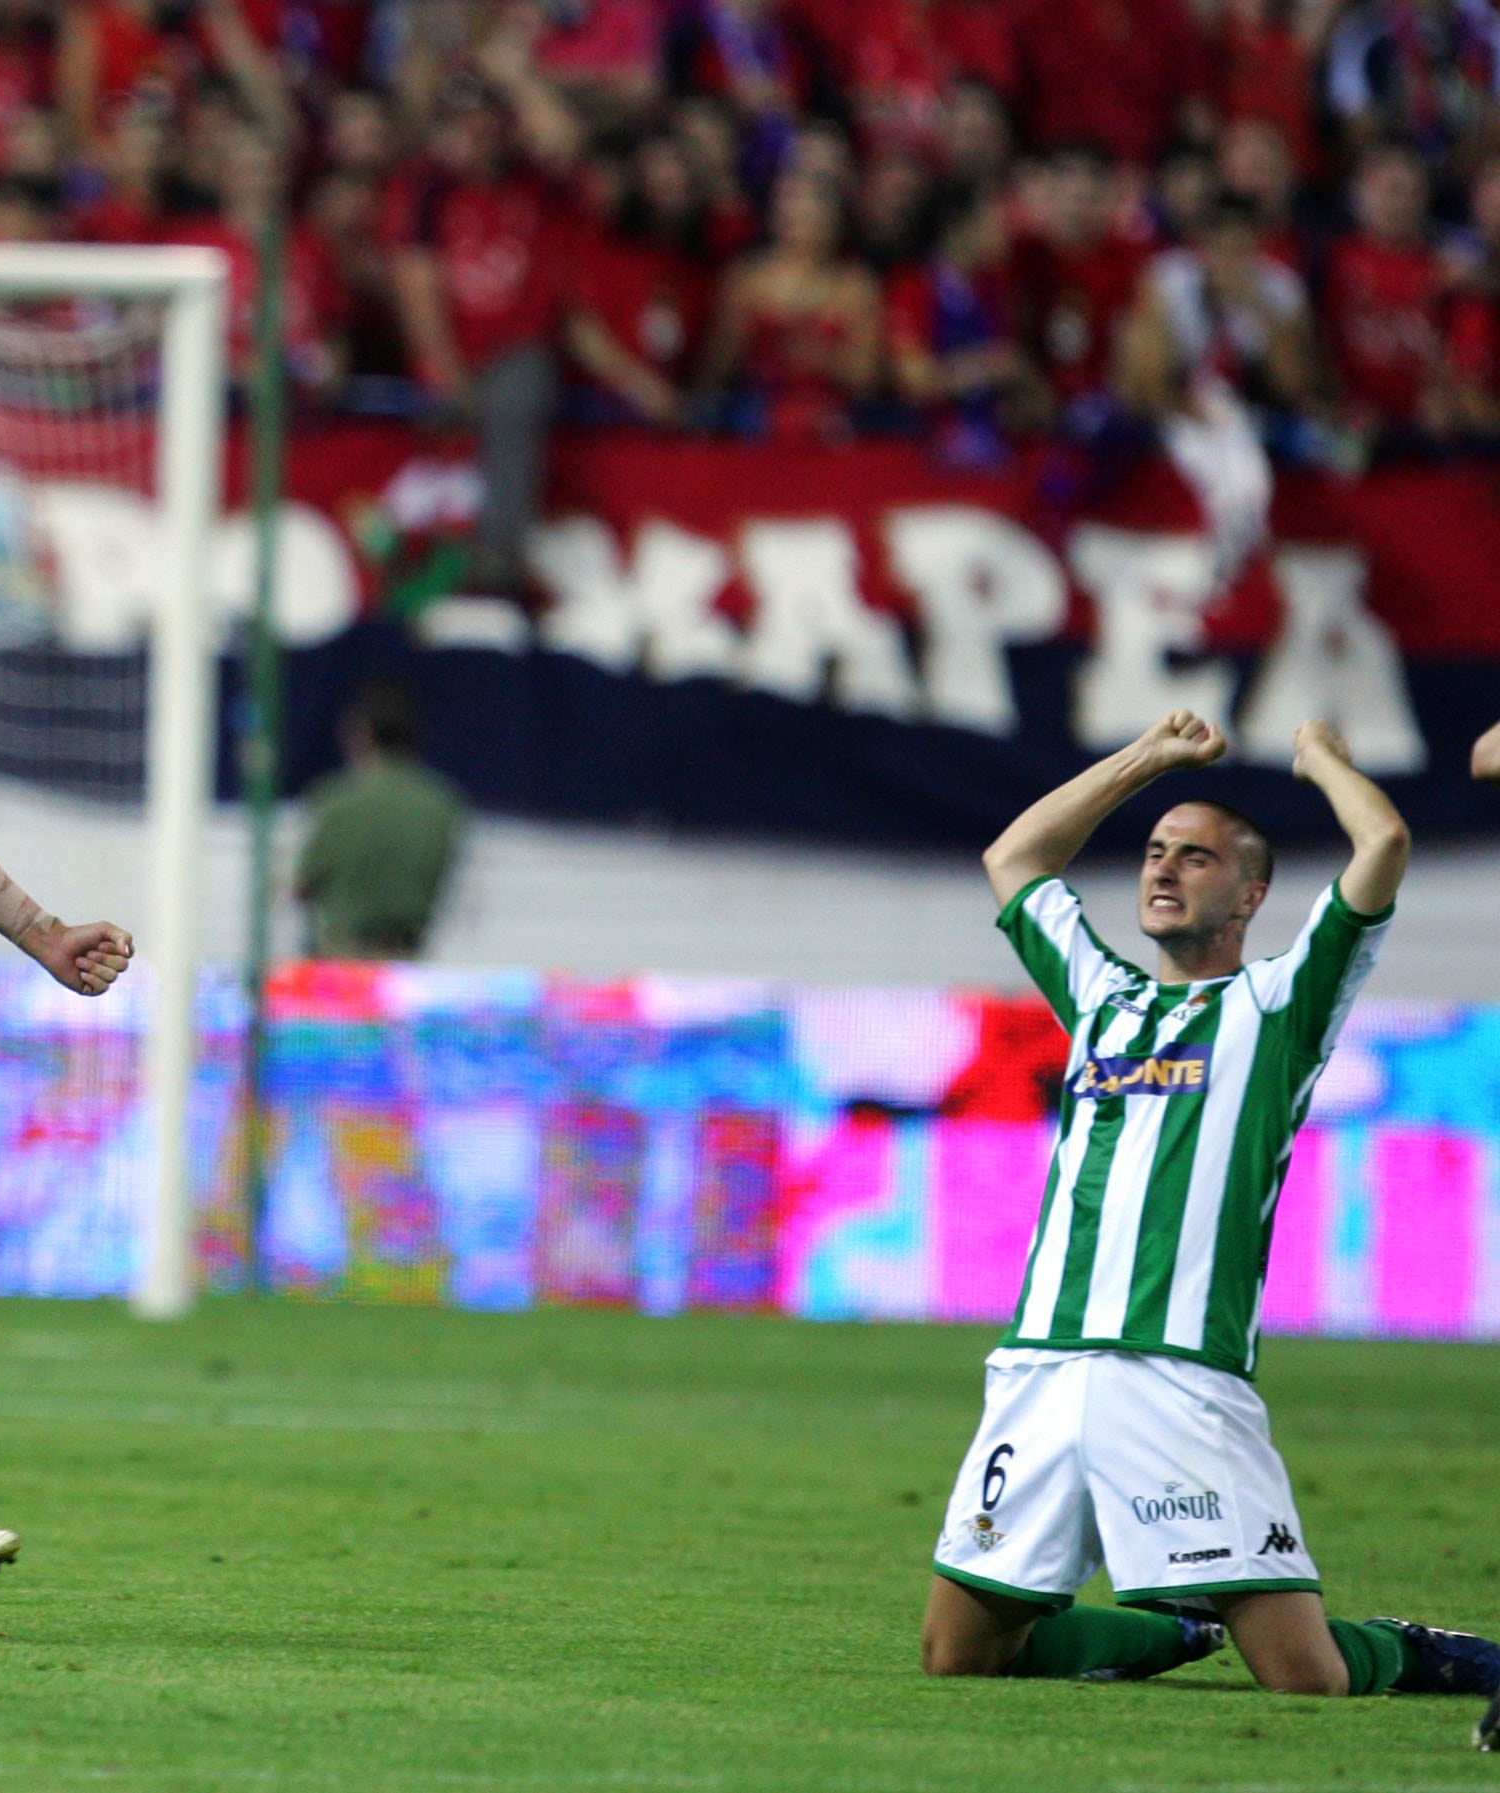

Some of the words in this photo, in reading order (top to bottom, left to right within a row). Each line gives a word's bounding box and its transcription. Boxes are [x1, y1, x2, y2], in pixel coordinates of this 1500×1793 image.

[981, 1443, 1014, 1511] 6
[1131, 1490, 1223, 1525] COOSUR
[1168, 1547, 1232, 1564] Kappa
